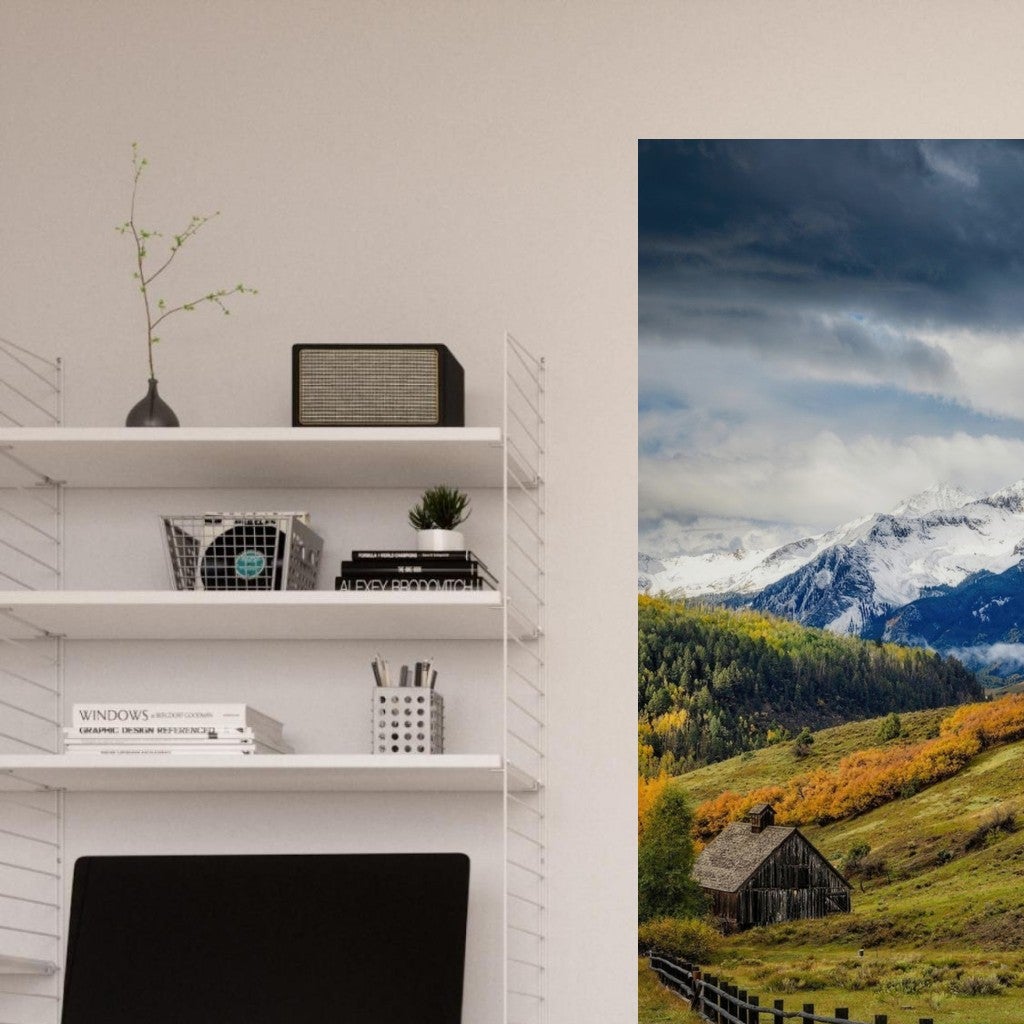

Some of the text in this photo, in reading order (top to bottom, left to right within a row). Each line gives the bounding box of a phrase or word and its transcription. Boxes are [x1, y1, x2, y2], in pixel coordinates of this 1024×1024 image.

[340, 578, 473, 590] ALEXEY BRODOVITCH
[79, 709, 149, 721] WINDOWS
[79, 726, 216, 734] GRAPHIC DESIGN REFERENCED
